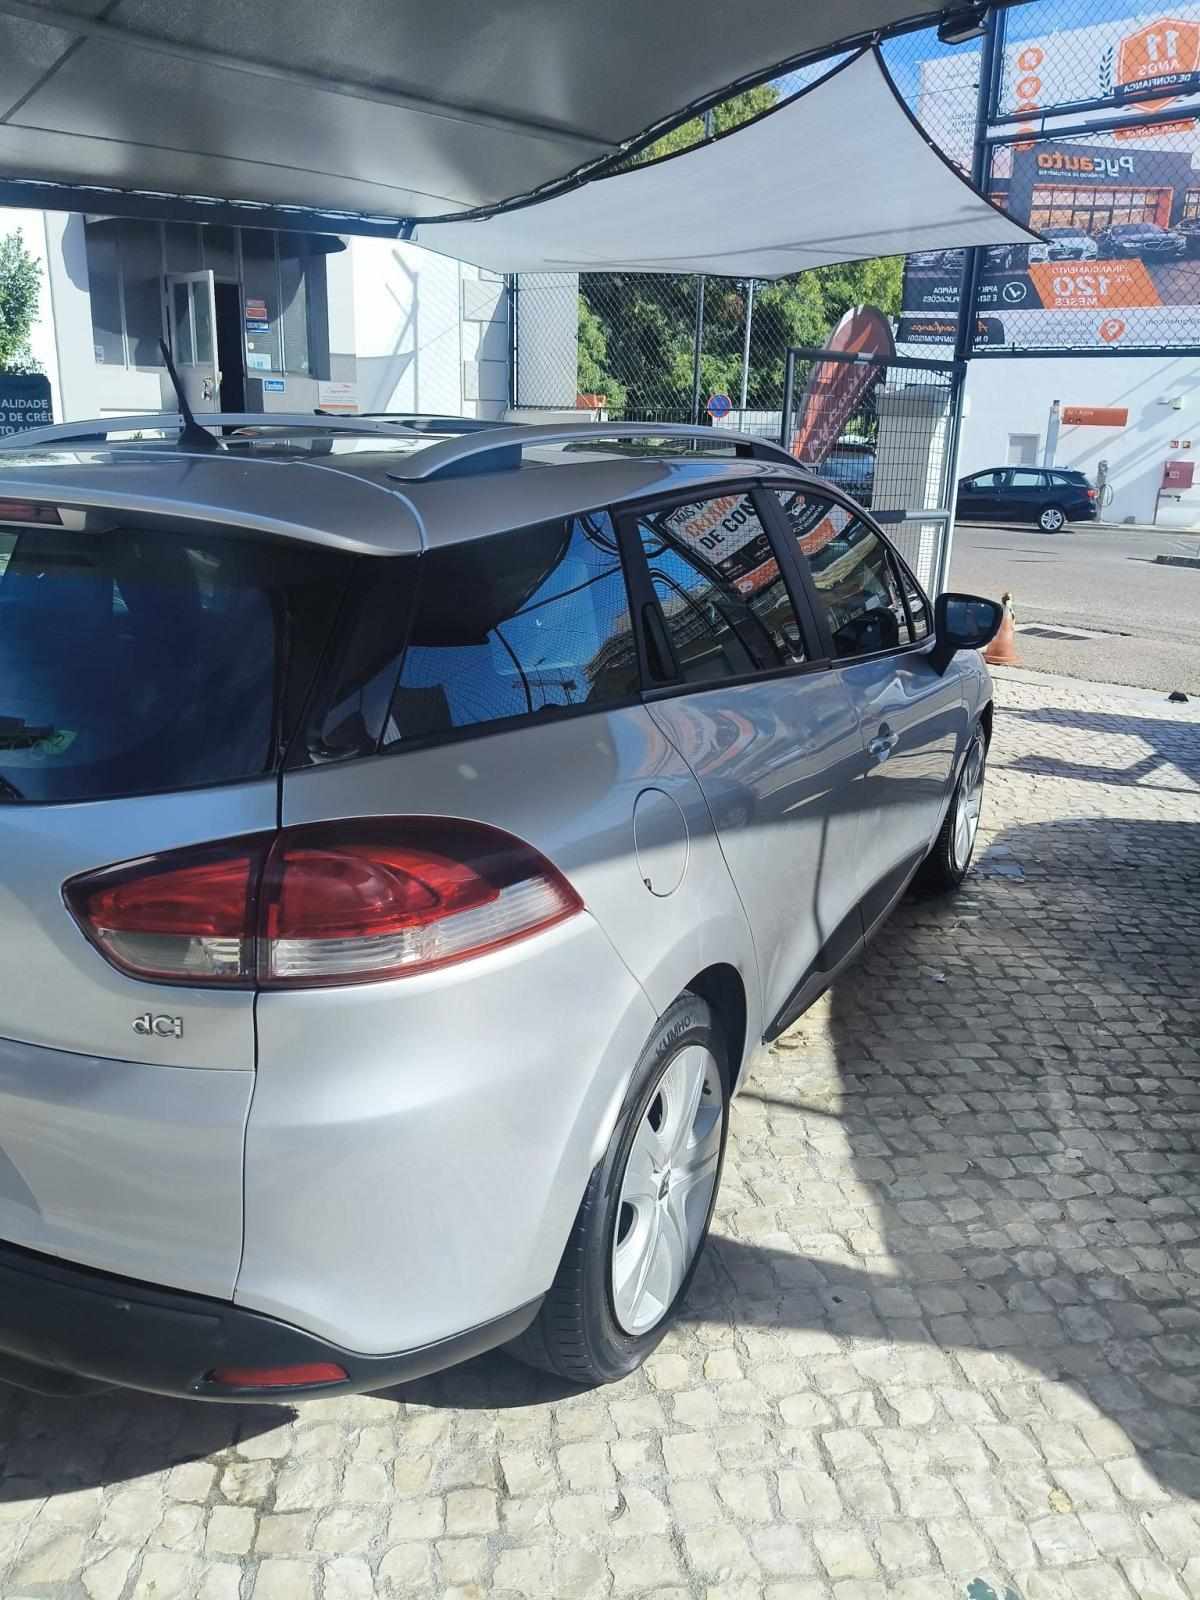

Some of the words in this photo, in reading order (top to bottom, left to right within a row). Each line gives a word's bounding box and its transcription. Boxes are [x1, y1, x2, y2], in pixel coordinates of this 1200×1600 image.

[0, 399, 49, 409] ALIDADE
[9, 412, 24, 422] DE
[26, 410, 54, 422] CRÉD
[699, 529, 726, 550] DE
[655, 1015, 691, 1057] KUMHO
